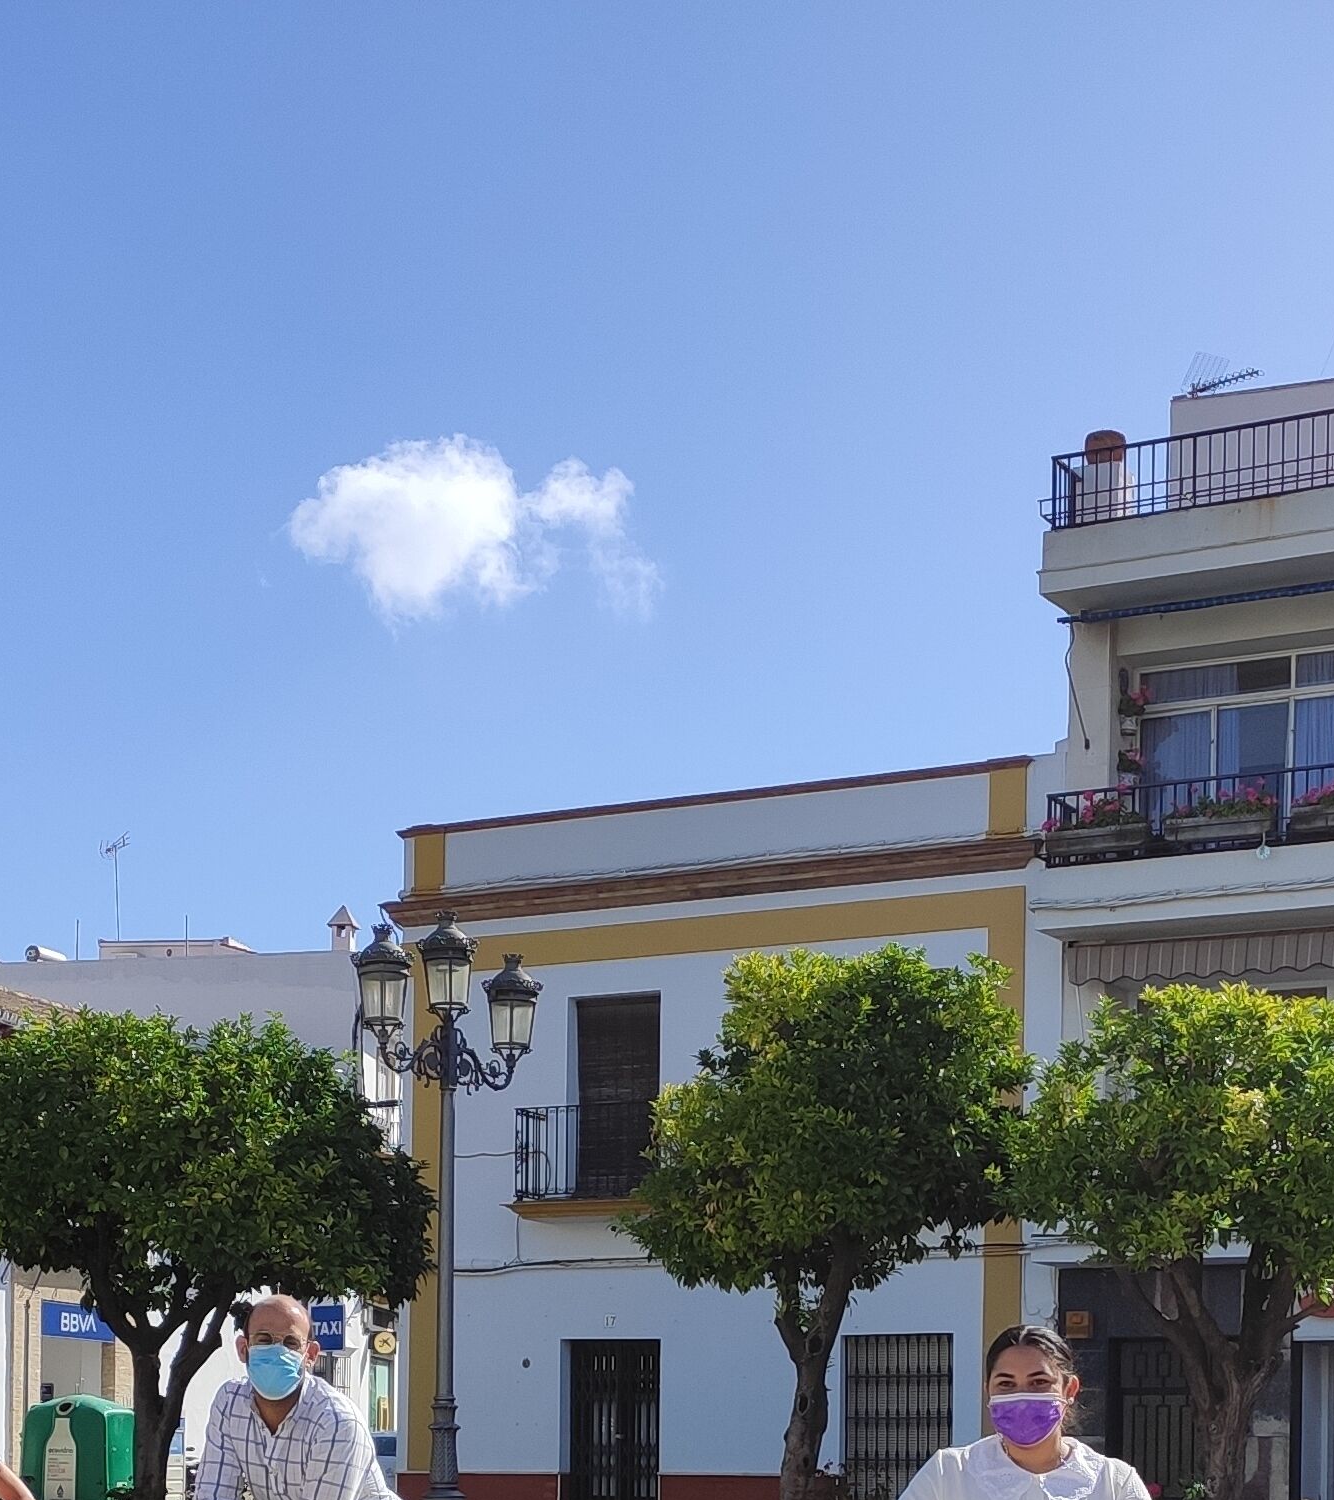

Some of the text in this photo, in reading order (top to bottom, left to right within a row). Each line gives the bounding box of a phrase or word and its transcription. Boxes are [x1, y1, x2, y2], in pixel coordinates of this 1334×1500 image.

[60, 1311, 97, 1333] BBVA
[313, 1320, 342, 1336] TAXI
[605, 1315, 616, 1327] 17
